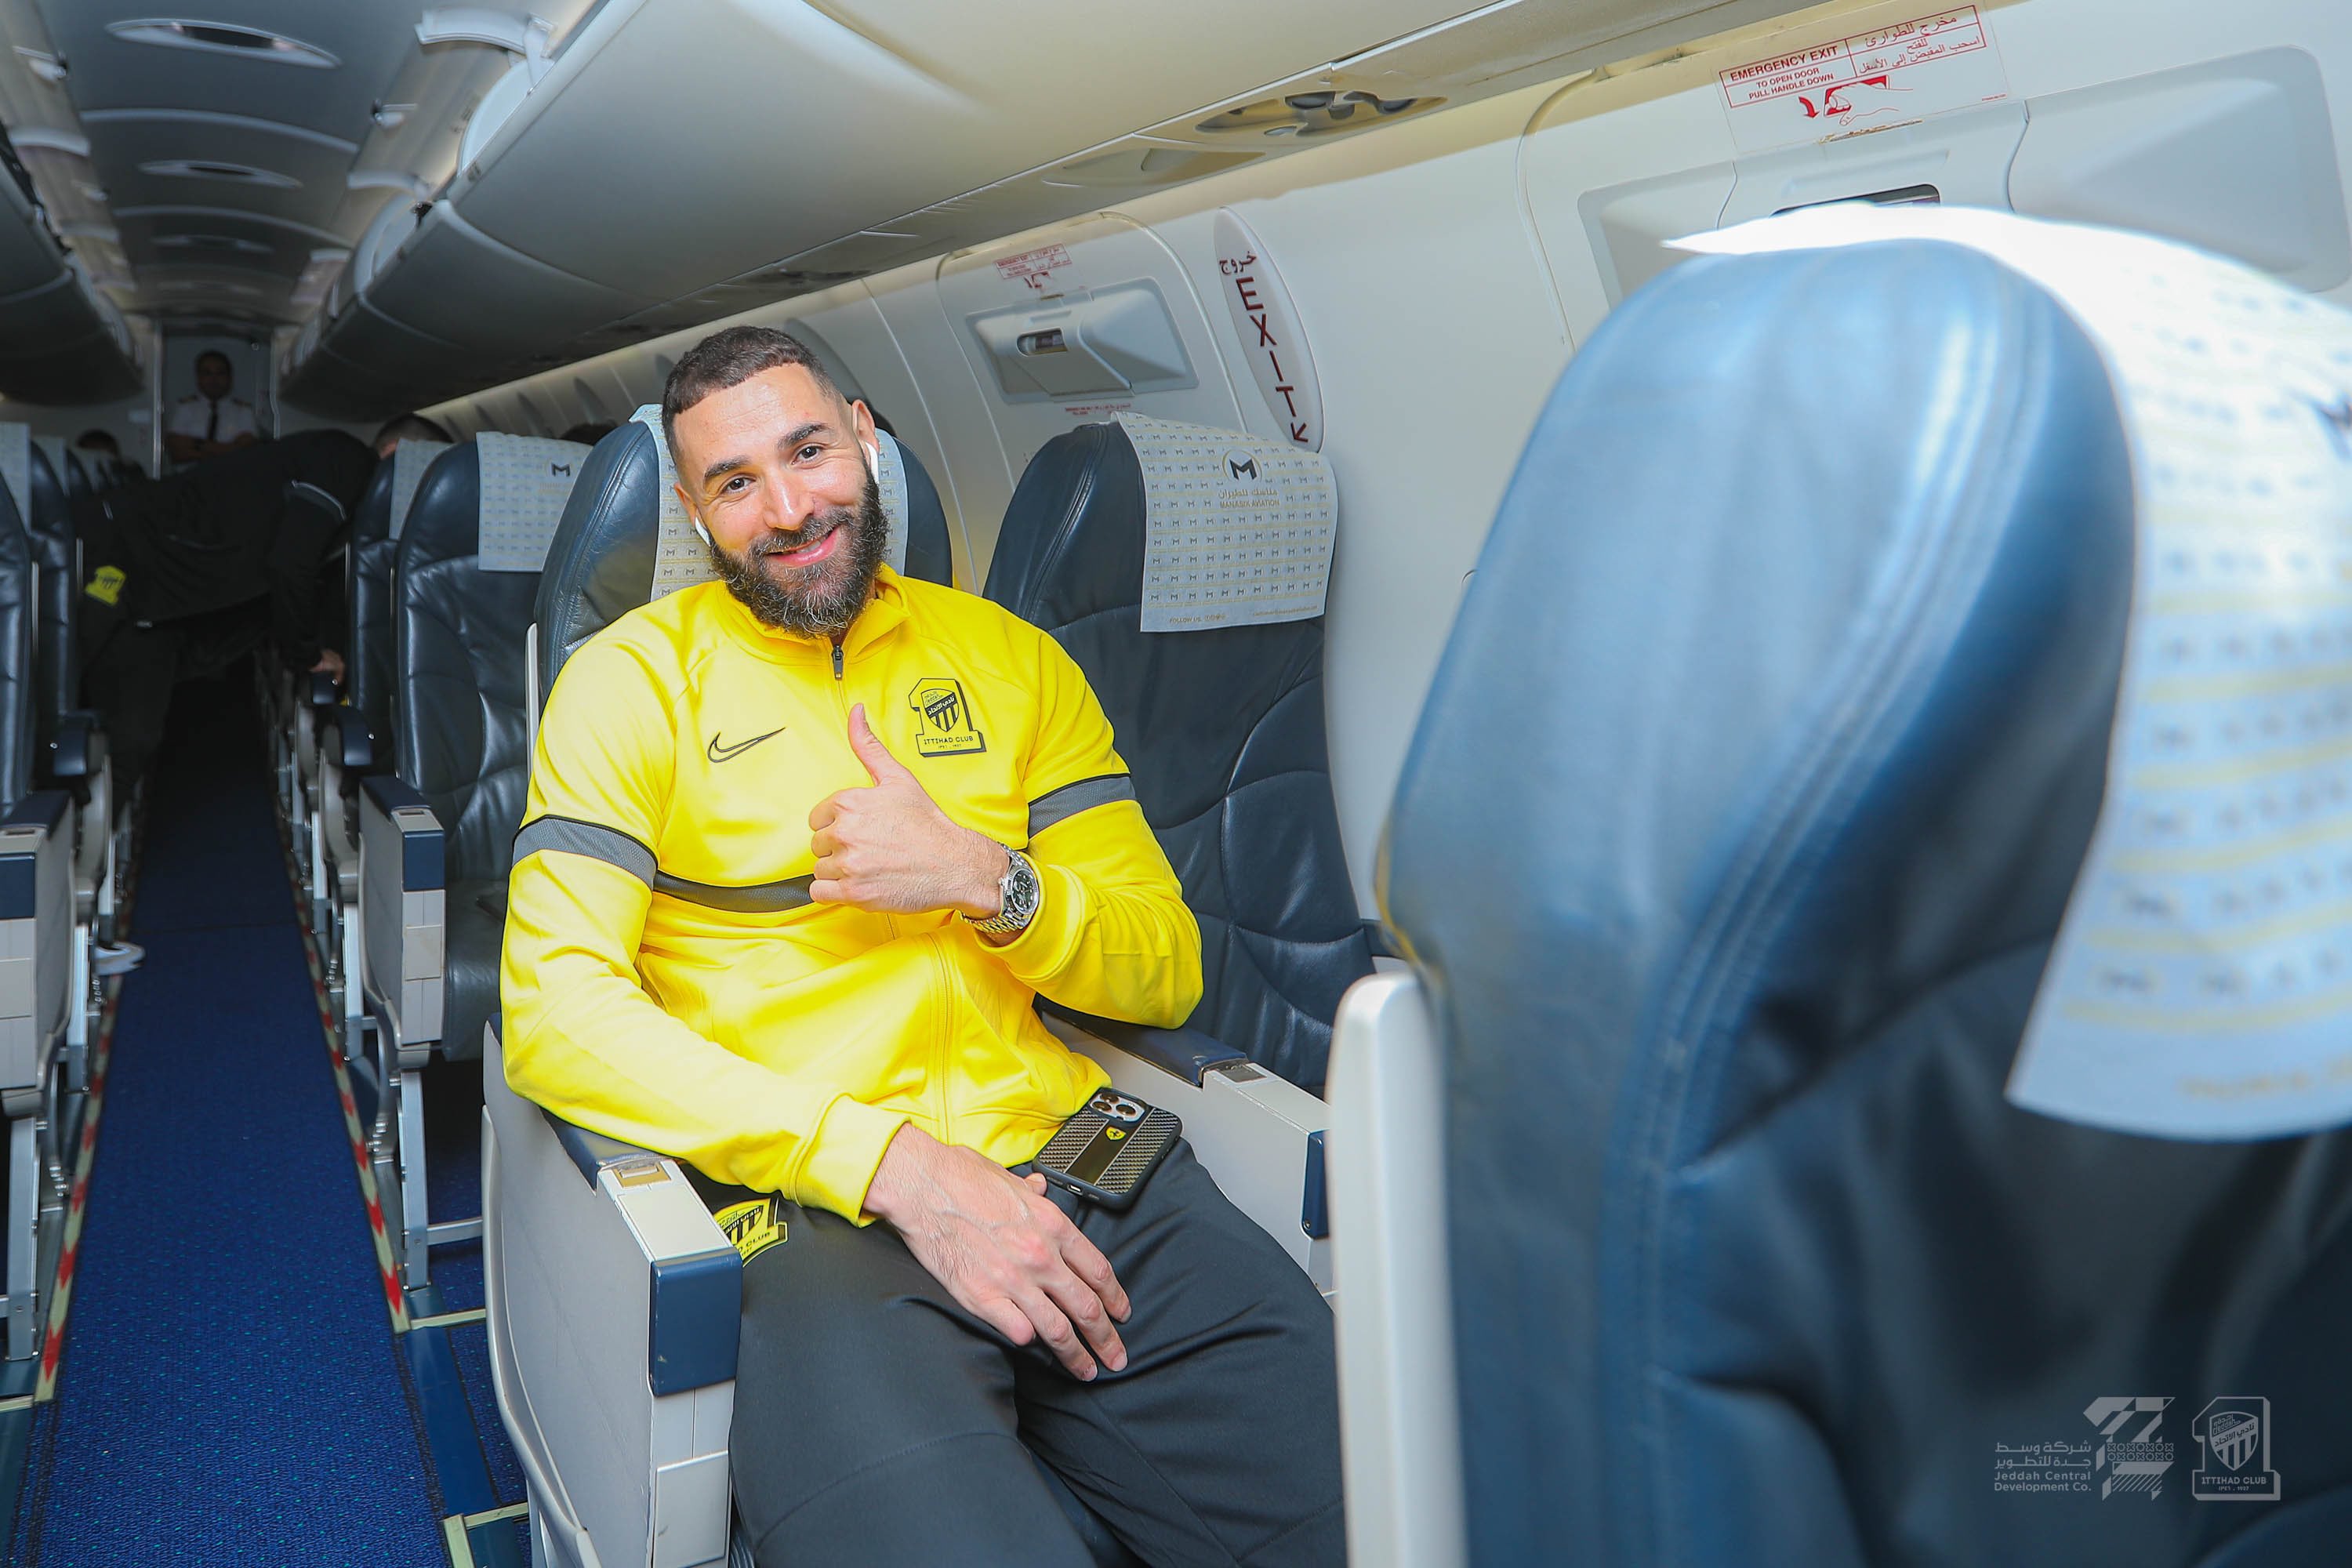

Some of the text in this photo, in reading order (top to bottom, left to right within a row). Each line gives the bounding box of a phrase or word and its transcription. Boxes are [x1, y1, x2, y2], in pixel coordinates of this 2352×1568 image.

[1920, 16, 1957, 36] مخرج
[1730, 45, 1838, 82] EMERGENCY EXIT
[1748, 73, 1834, 100] PULL HANDLE DOWN
[1769, 74, 1793, 85] OPEN
[1794, 67, 1820, 78] DOOR
[1219, 251, 1257, 274] خروج
[1236, 276, 1297, 416] EXIT
[551, 463, 571, 477] M
[1229, 458, 1258, 481] M
[1252, 499, 1280, 508] AVIATION
